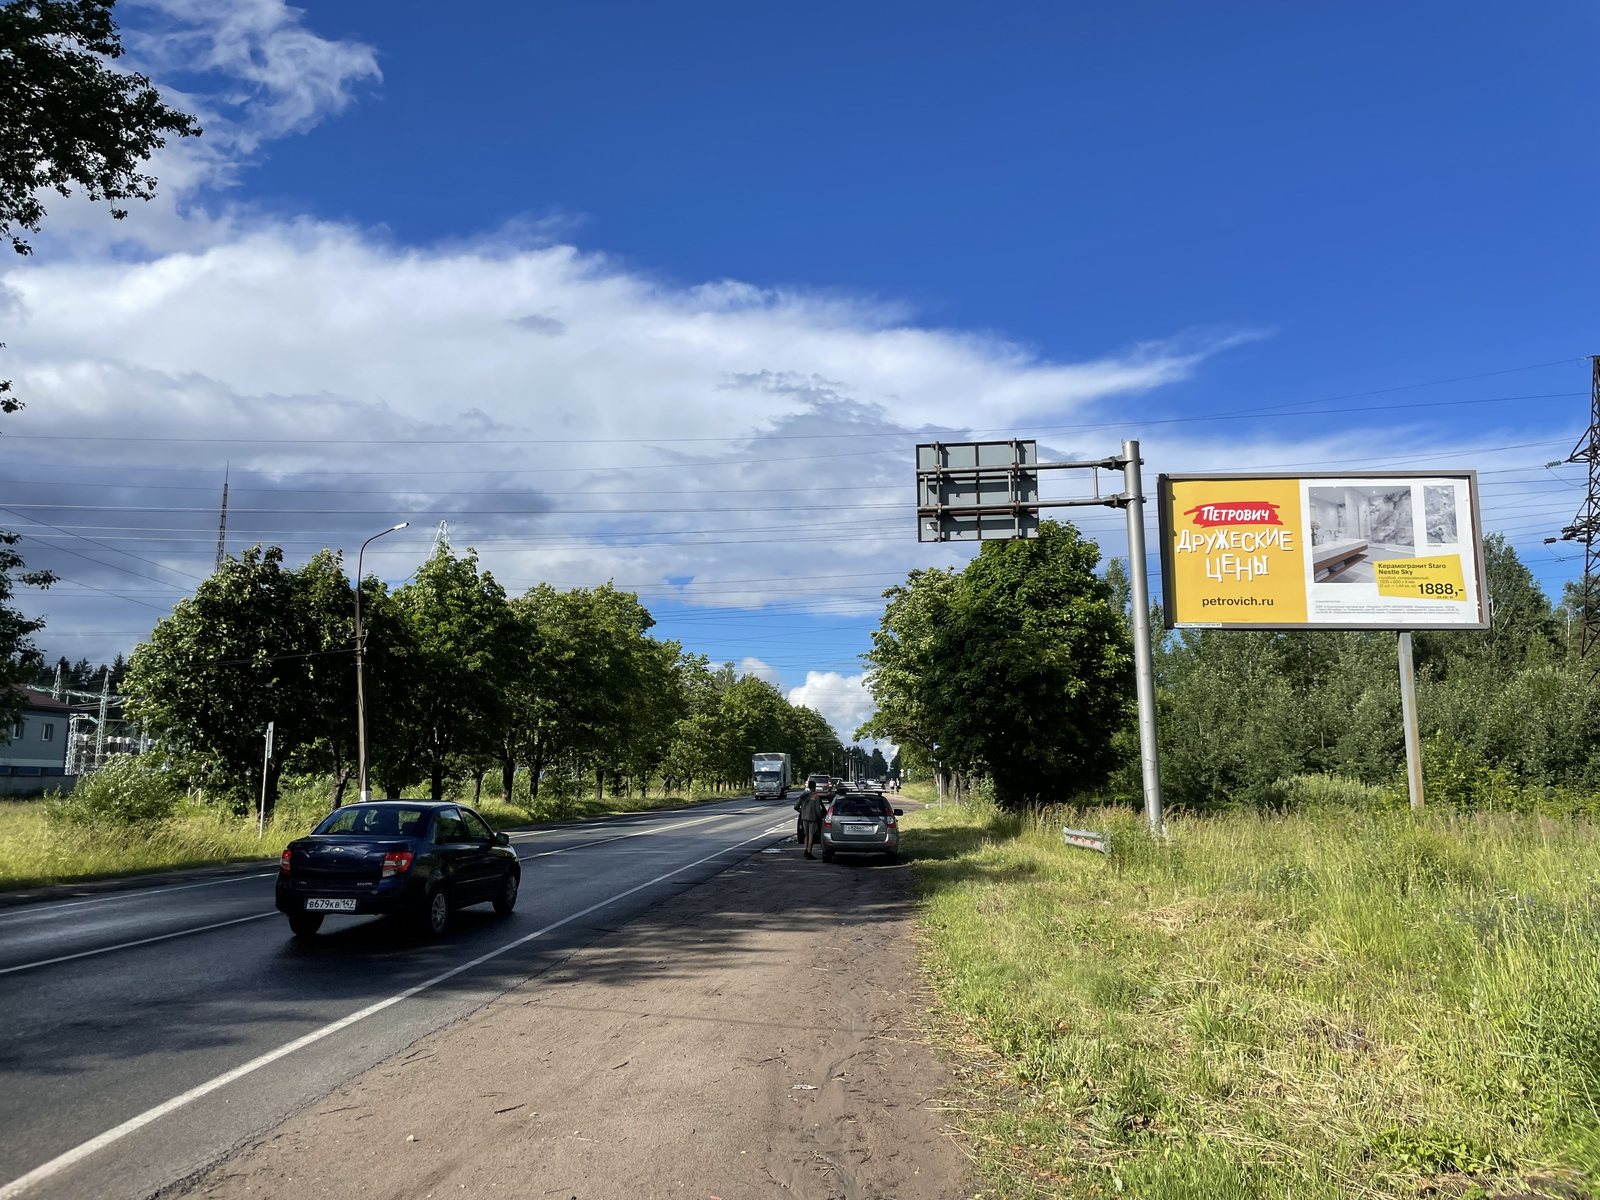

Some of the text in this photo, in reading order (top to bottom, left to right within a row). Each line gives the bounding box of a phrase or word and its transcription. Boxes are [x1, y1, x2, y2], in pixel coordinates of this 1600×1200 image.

[1201, 505, 1270, 522] ПЕТРОВИЧ
[1176, 527, 1294, 555] ДРУЖЕСКИЕ
[1205, 553, 1269, 583] ЦЕНЫ
[1378, 562, 1427, 570] Керамогранит
[1202, 596, 1274, 608] petrovich.ru
